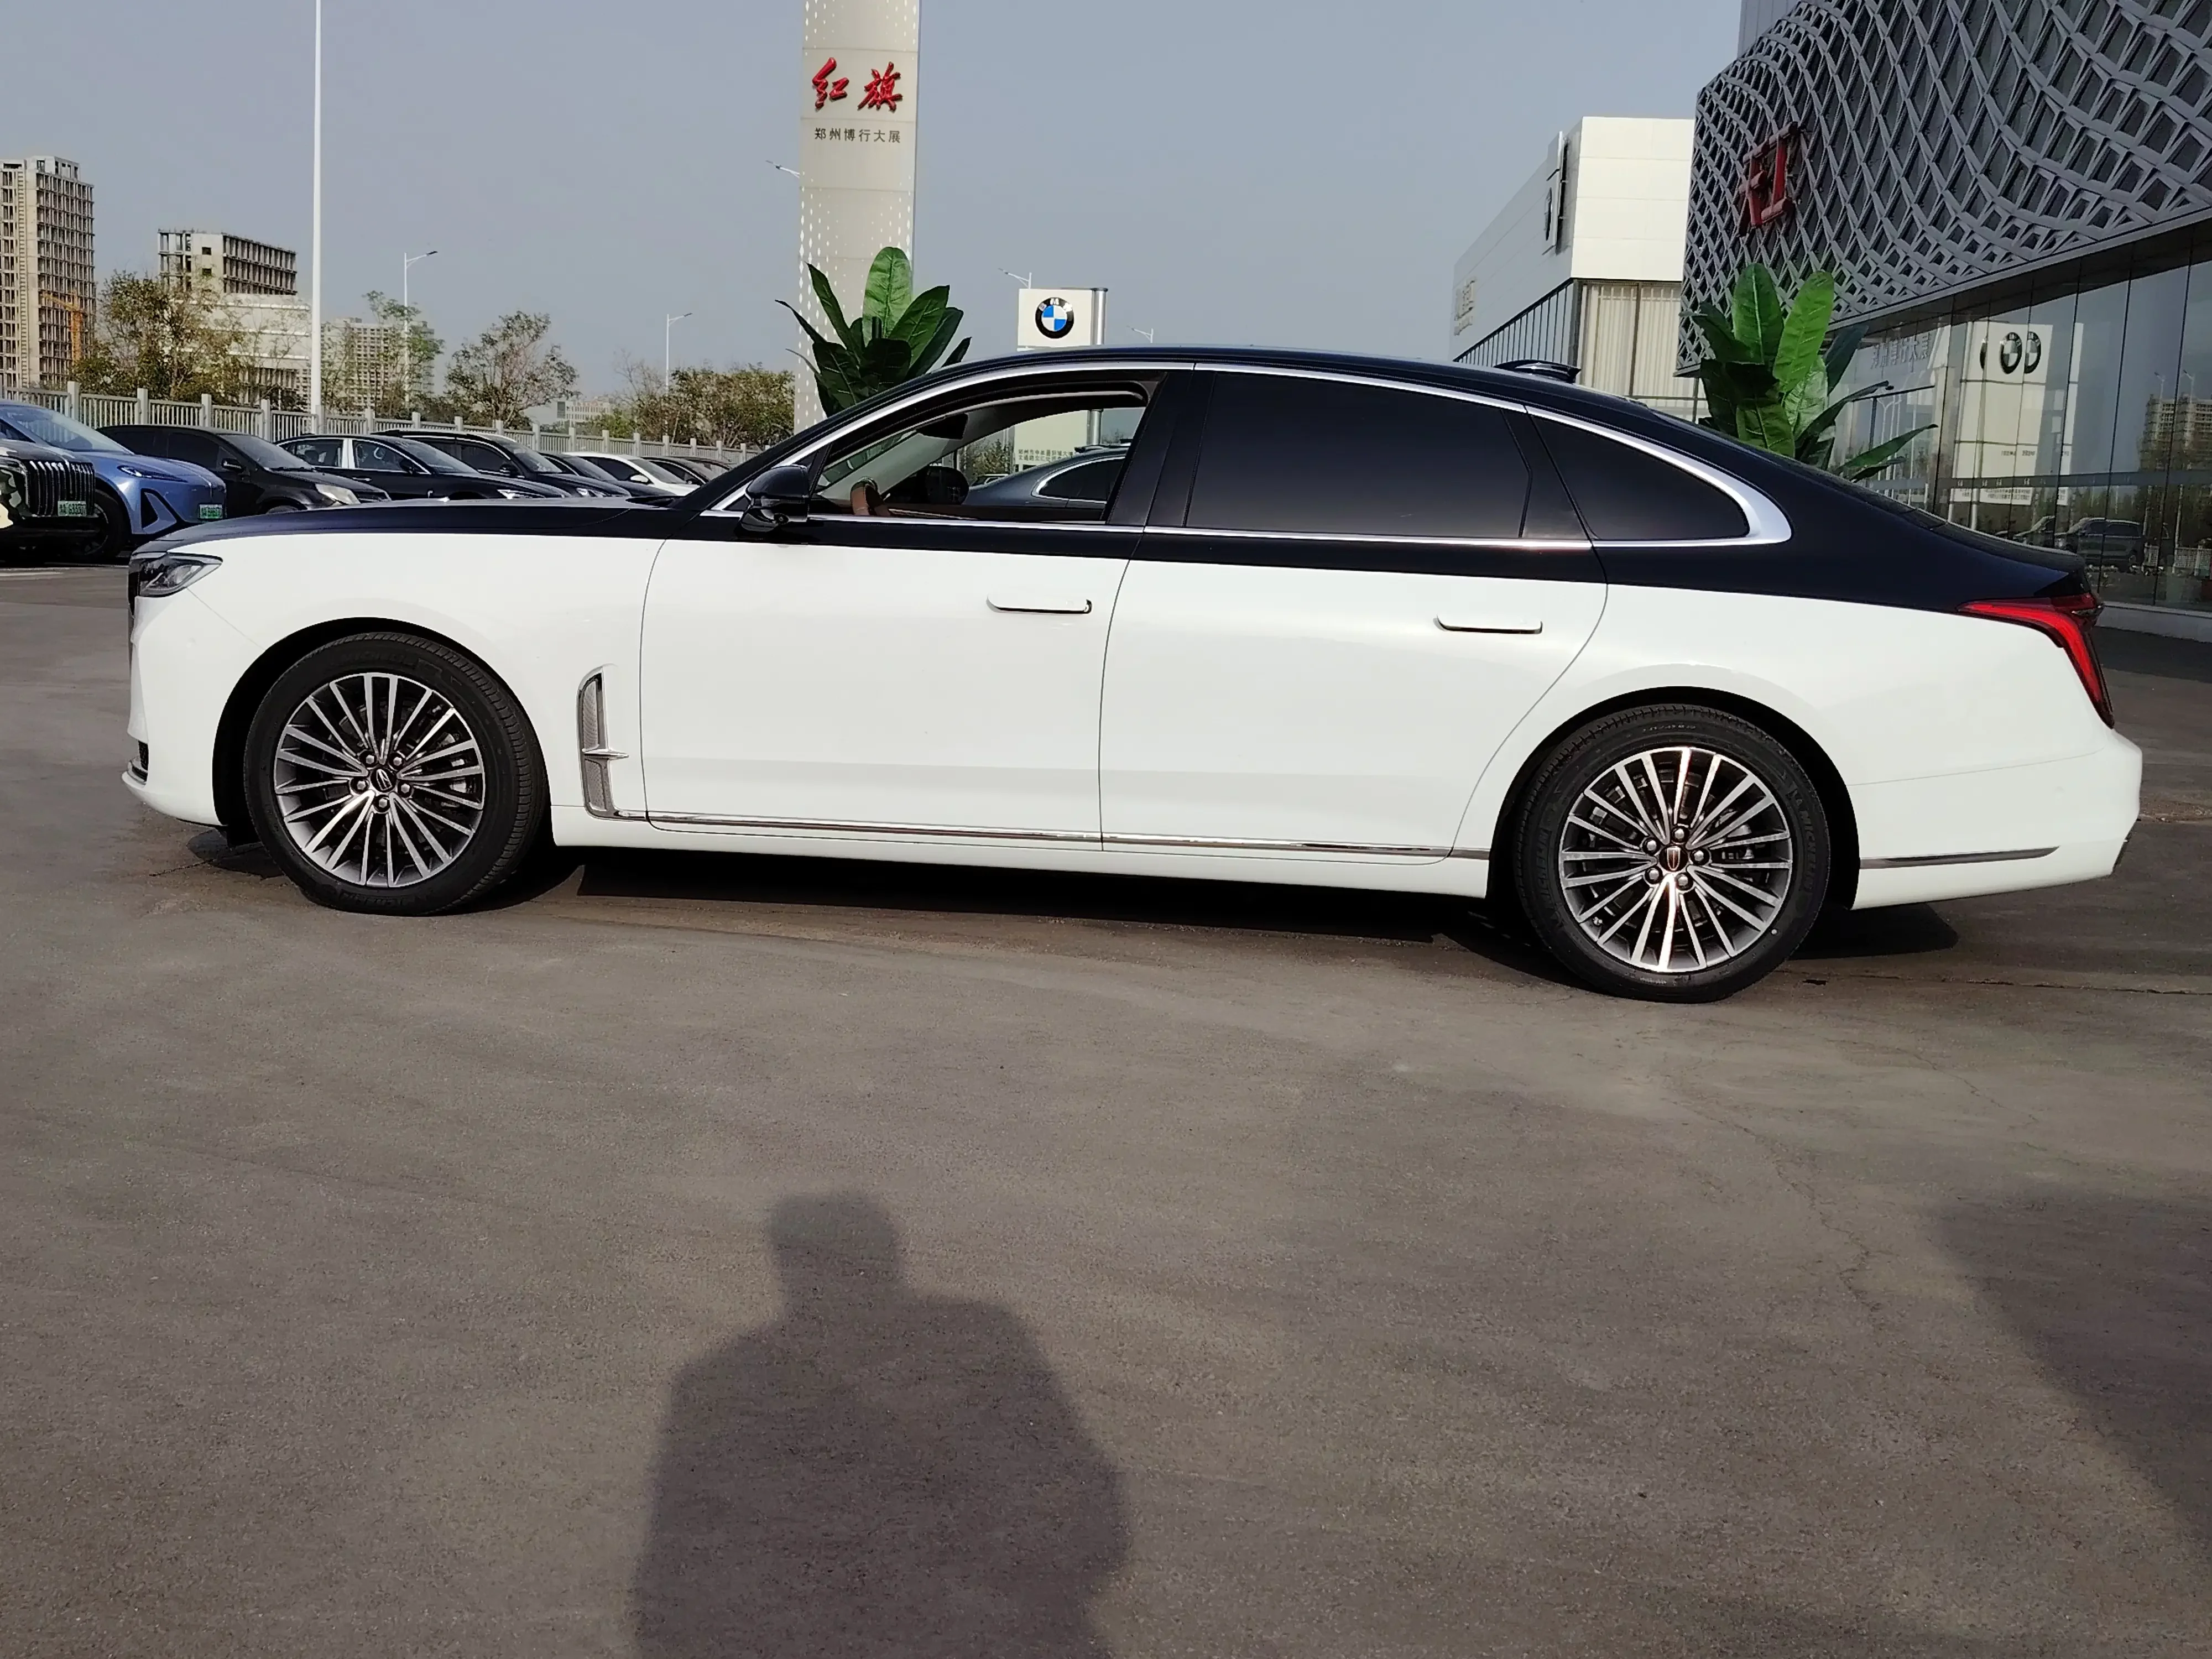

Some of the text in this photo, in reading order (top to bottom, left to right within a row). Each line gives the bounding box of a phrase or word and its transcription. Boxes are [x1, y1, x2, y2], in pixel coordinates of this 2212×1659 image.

[812, 57, 903, 112] 红旗
[815, 128, 901, 143] 郑州博行大展
